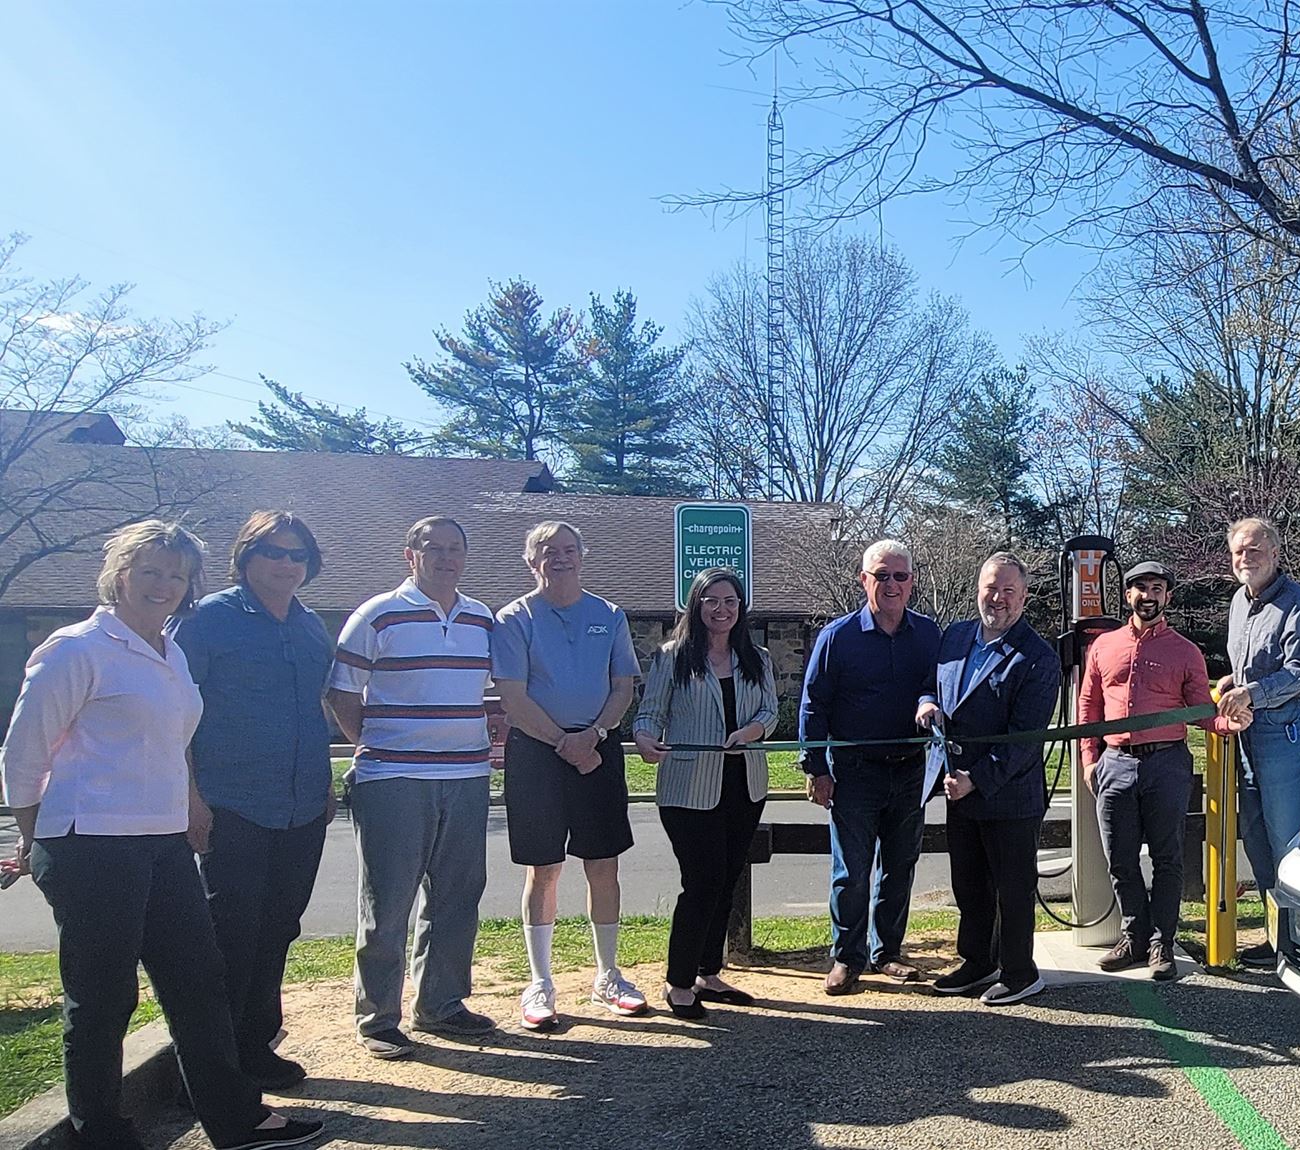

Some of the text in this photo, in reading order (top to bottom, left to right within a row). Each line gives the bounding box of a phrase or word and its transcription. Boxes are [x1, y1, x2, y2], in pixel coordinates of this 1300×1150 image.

[685, 546, 742, 555] ELECTRIC
[689, 558, 739, 567] VEHICLE
[1082, 581, 1100, 594] EV
